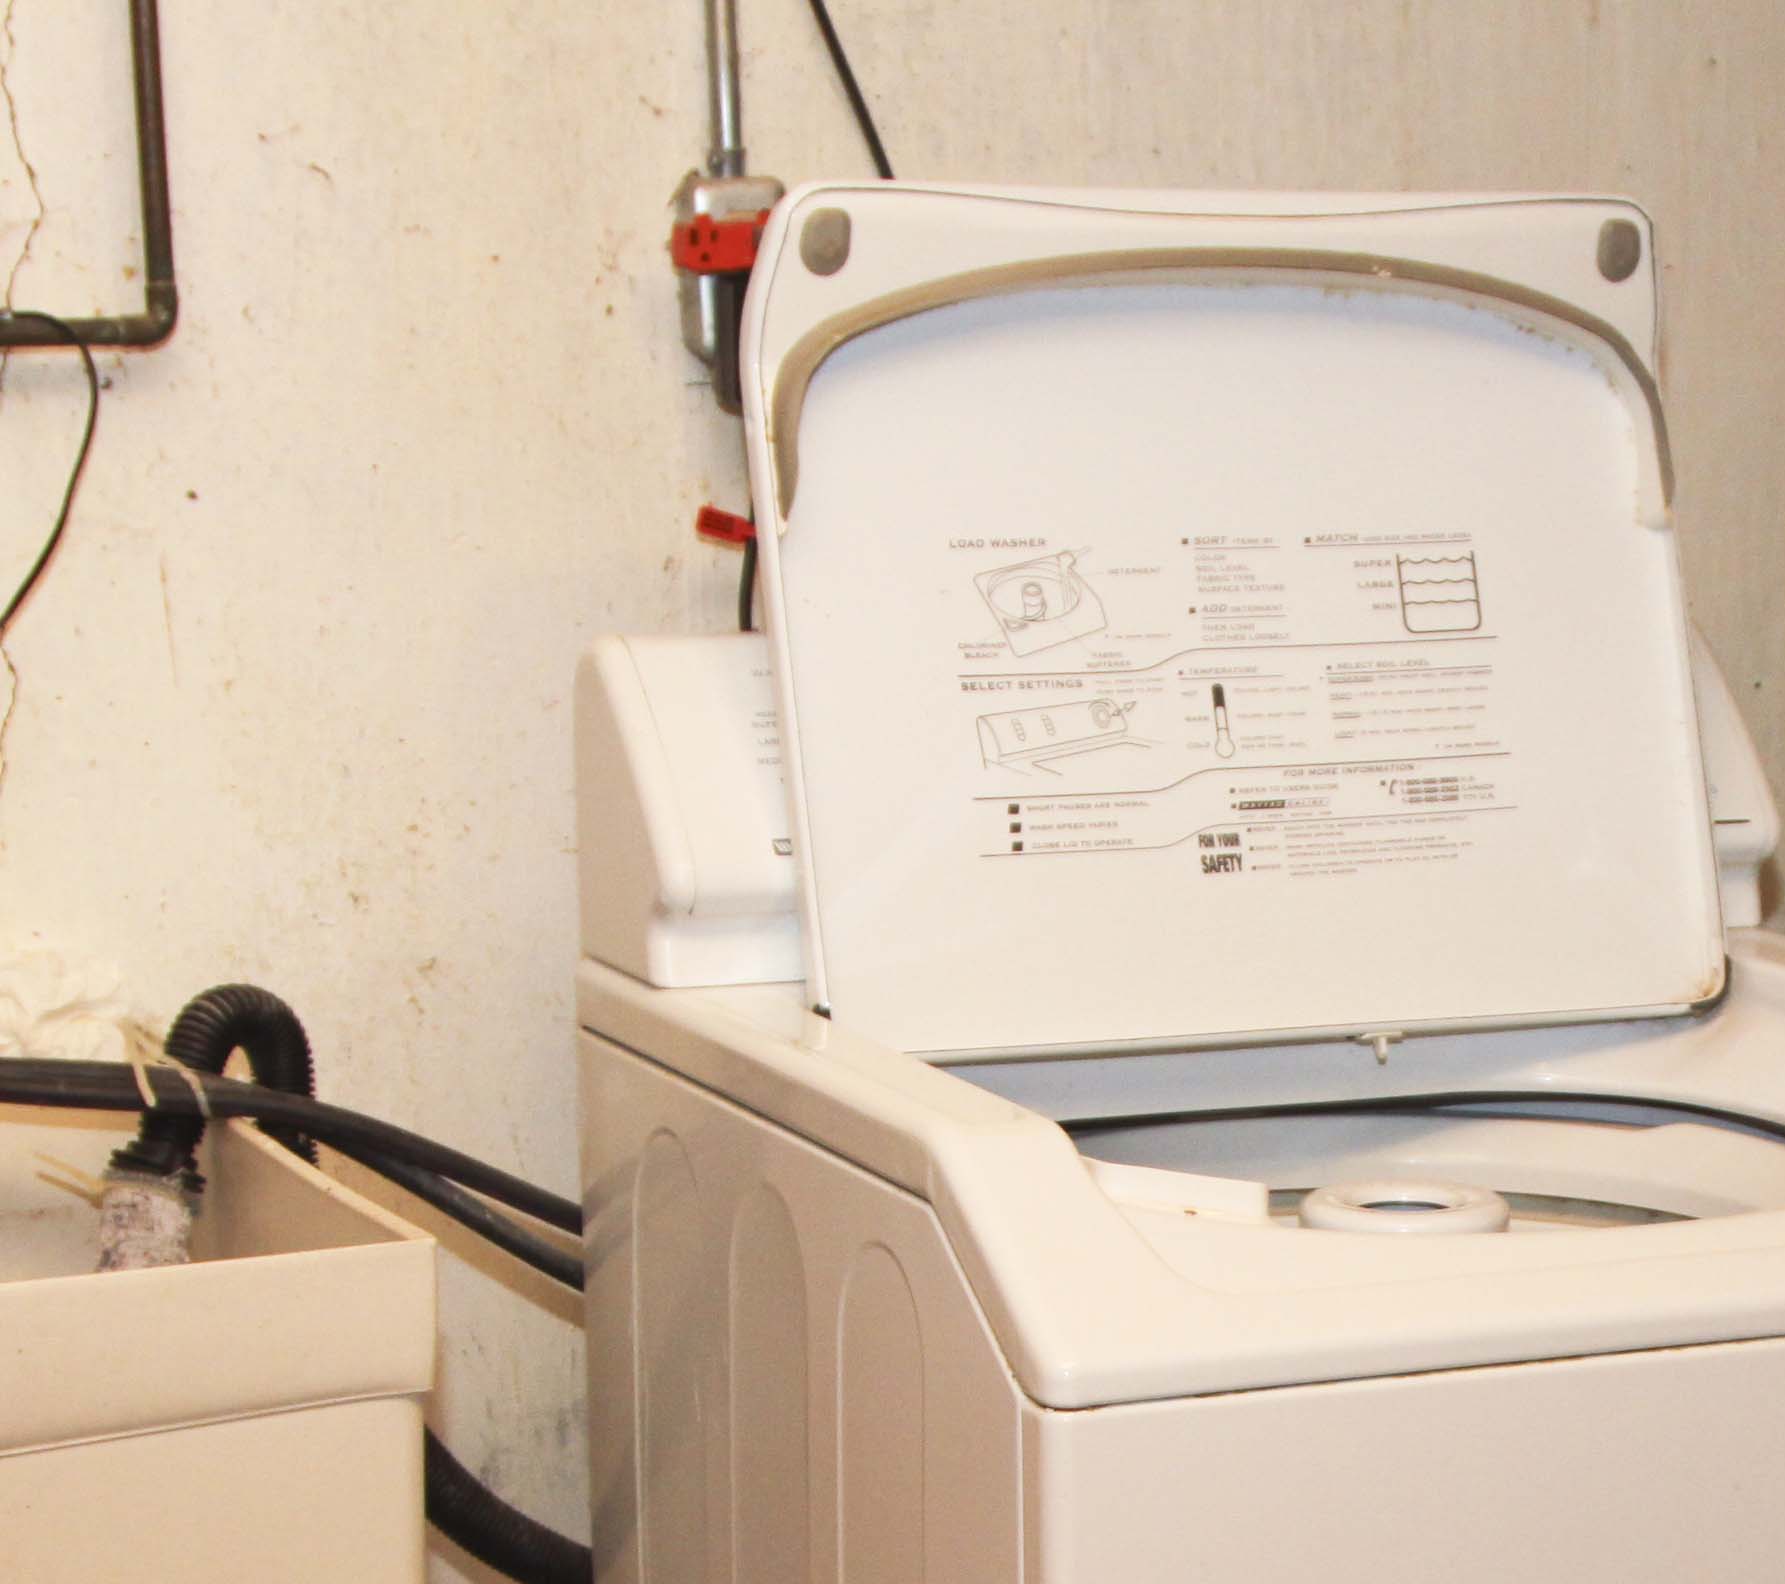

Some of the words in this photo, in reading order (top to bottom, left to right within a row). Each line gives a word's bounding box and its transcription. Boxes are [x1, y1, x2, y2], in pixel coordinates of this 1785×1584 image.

[949, 539, 985, 549] LOAD
[991, 537, 1047, 548] WASHER
[1353, 559, 1392, 568] SUPER
[961, 680, 1012, 691] SELECT
[1019, 679, 1083, 690] SETTINGS
[1283, 768, 1304, 778] FOR
[1308, 766, 1337, 777] MORE
[1342, 763, 1415, 775] INFORMATION
[1198, 833, 1215, 848] FOR
[1216, 832, 1241, 847] YOUR
[1200, 853, 1243, 874] SAFETY
